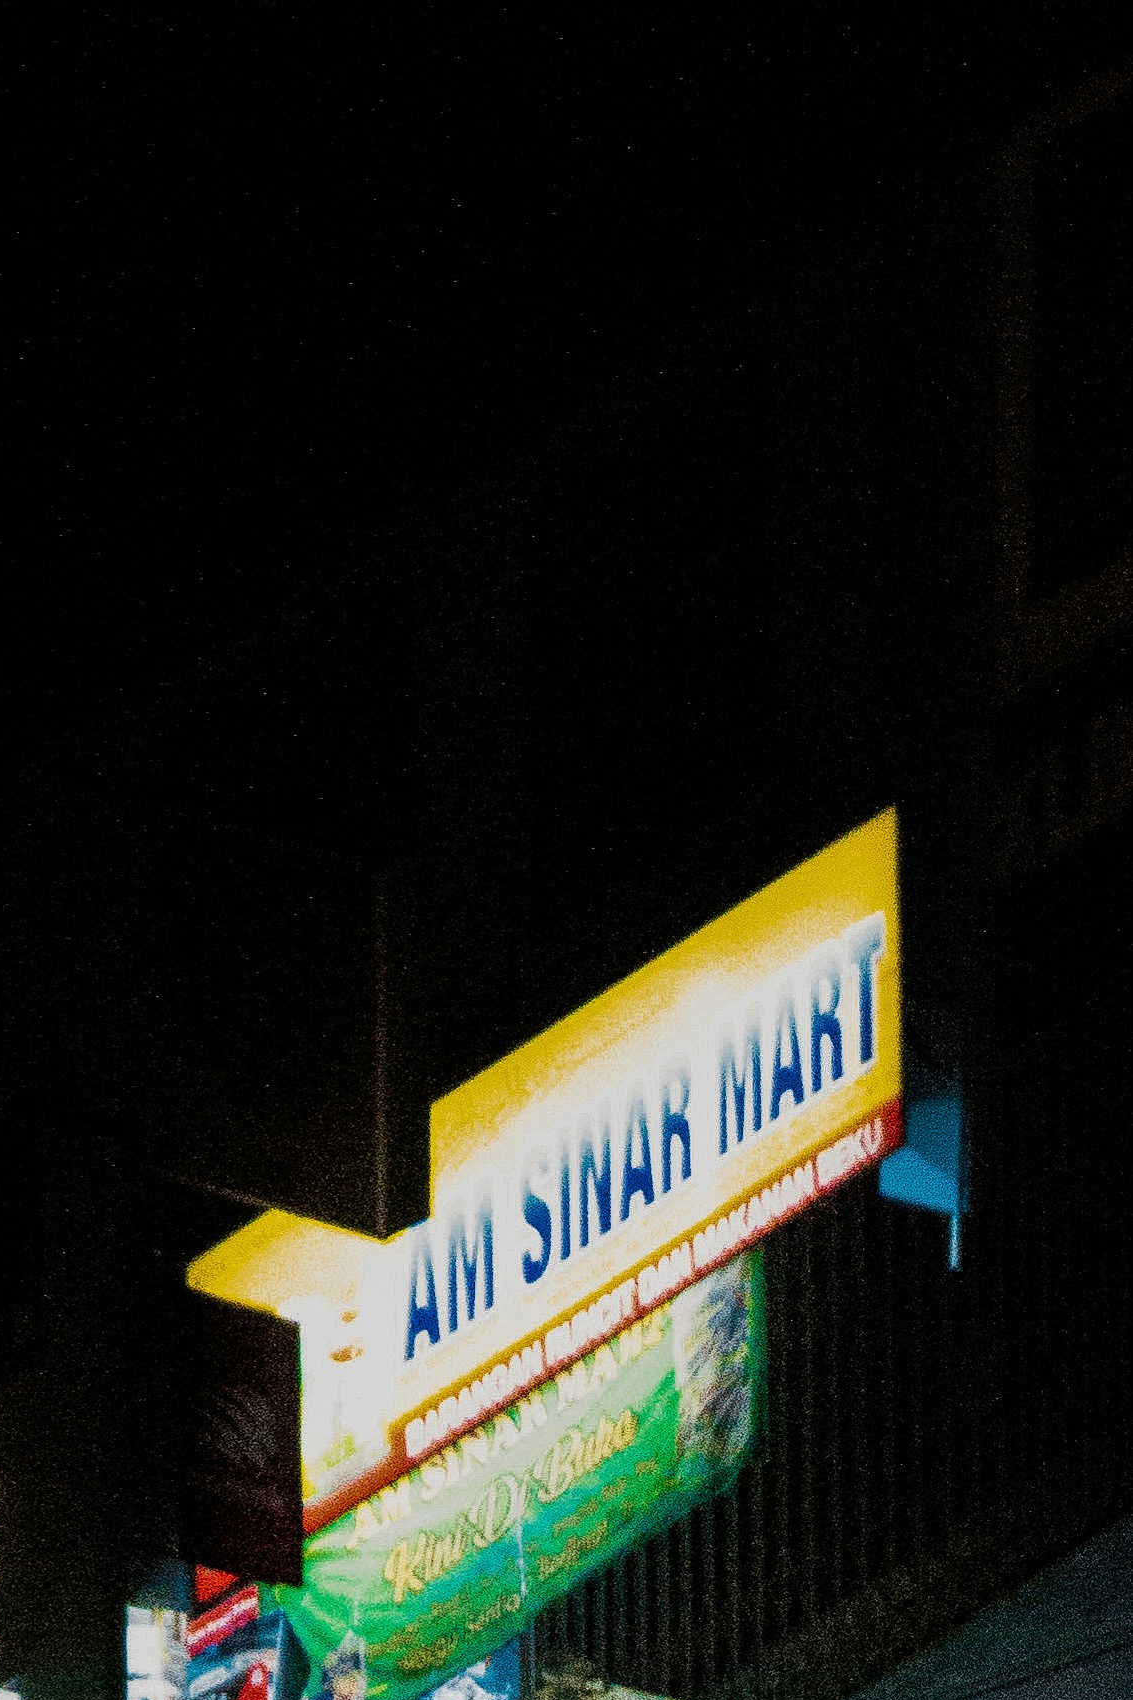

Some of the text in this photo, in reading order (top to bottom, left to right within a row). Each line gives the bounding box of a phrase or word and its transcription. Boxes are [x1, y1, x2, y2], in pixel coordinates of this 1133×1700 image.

[403, 915, 884, 1362] AM SINAR MART
